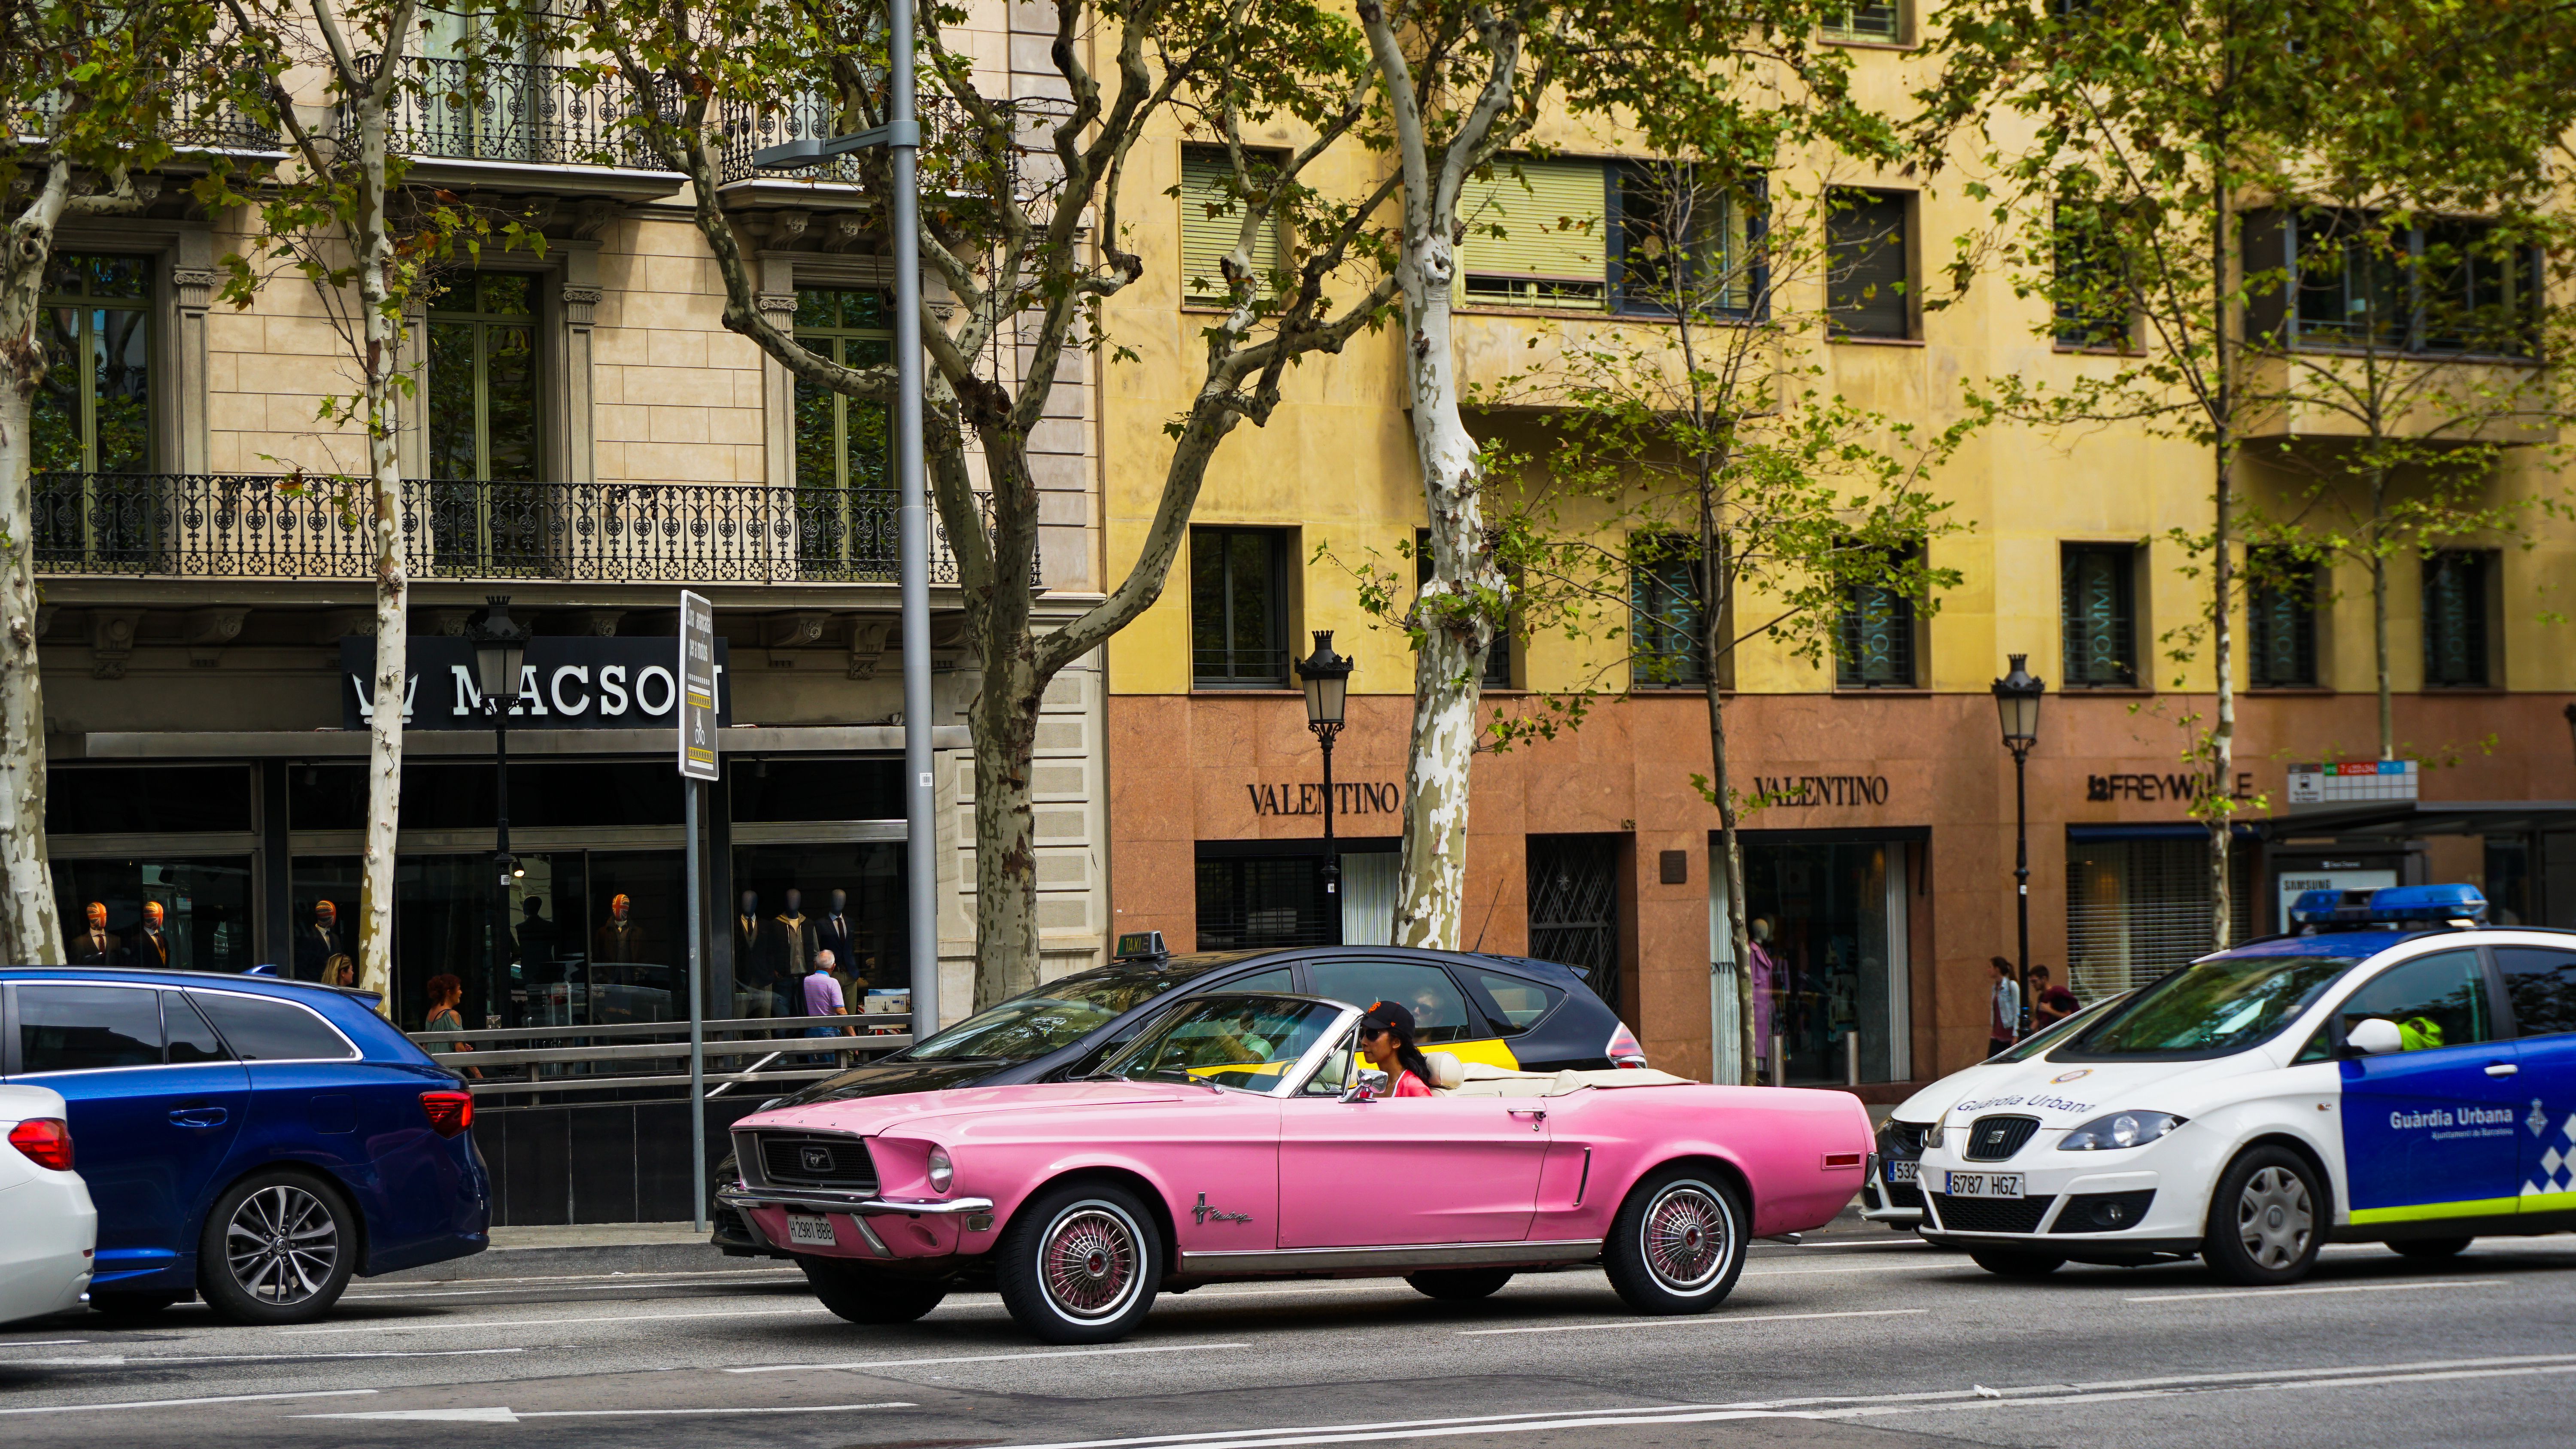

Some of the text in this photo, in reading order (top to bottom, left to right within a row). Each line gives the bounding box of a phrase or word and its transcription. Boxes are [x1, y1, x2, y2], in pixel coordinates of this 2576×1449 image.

[695, 641, 697, 658] a
[697, 639, 708, 662] motos
[451, 665, 722, 716] MACSO
[1754, 775, 1889, 807] VALENTINO
[2284, 879, 2331, 891] SAMSUNG
[1125, 937, 1141, 952] TAXI
[2027, 1094, 2096, 1112] Urbana
[2390, 1107, 2513, 1130] Guàrdia Urbana
[1897, 1163, 1919, 1179] 532
[1953, 1175, 2017, 1195] 6787 HGZ
[816, 1222, 833, 1239] BBB
